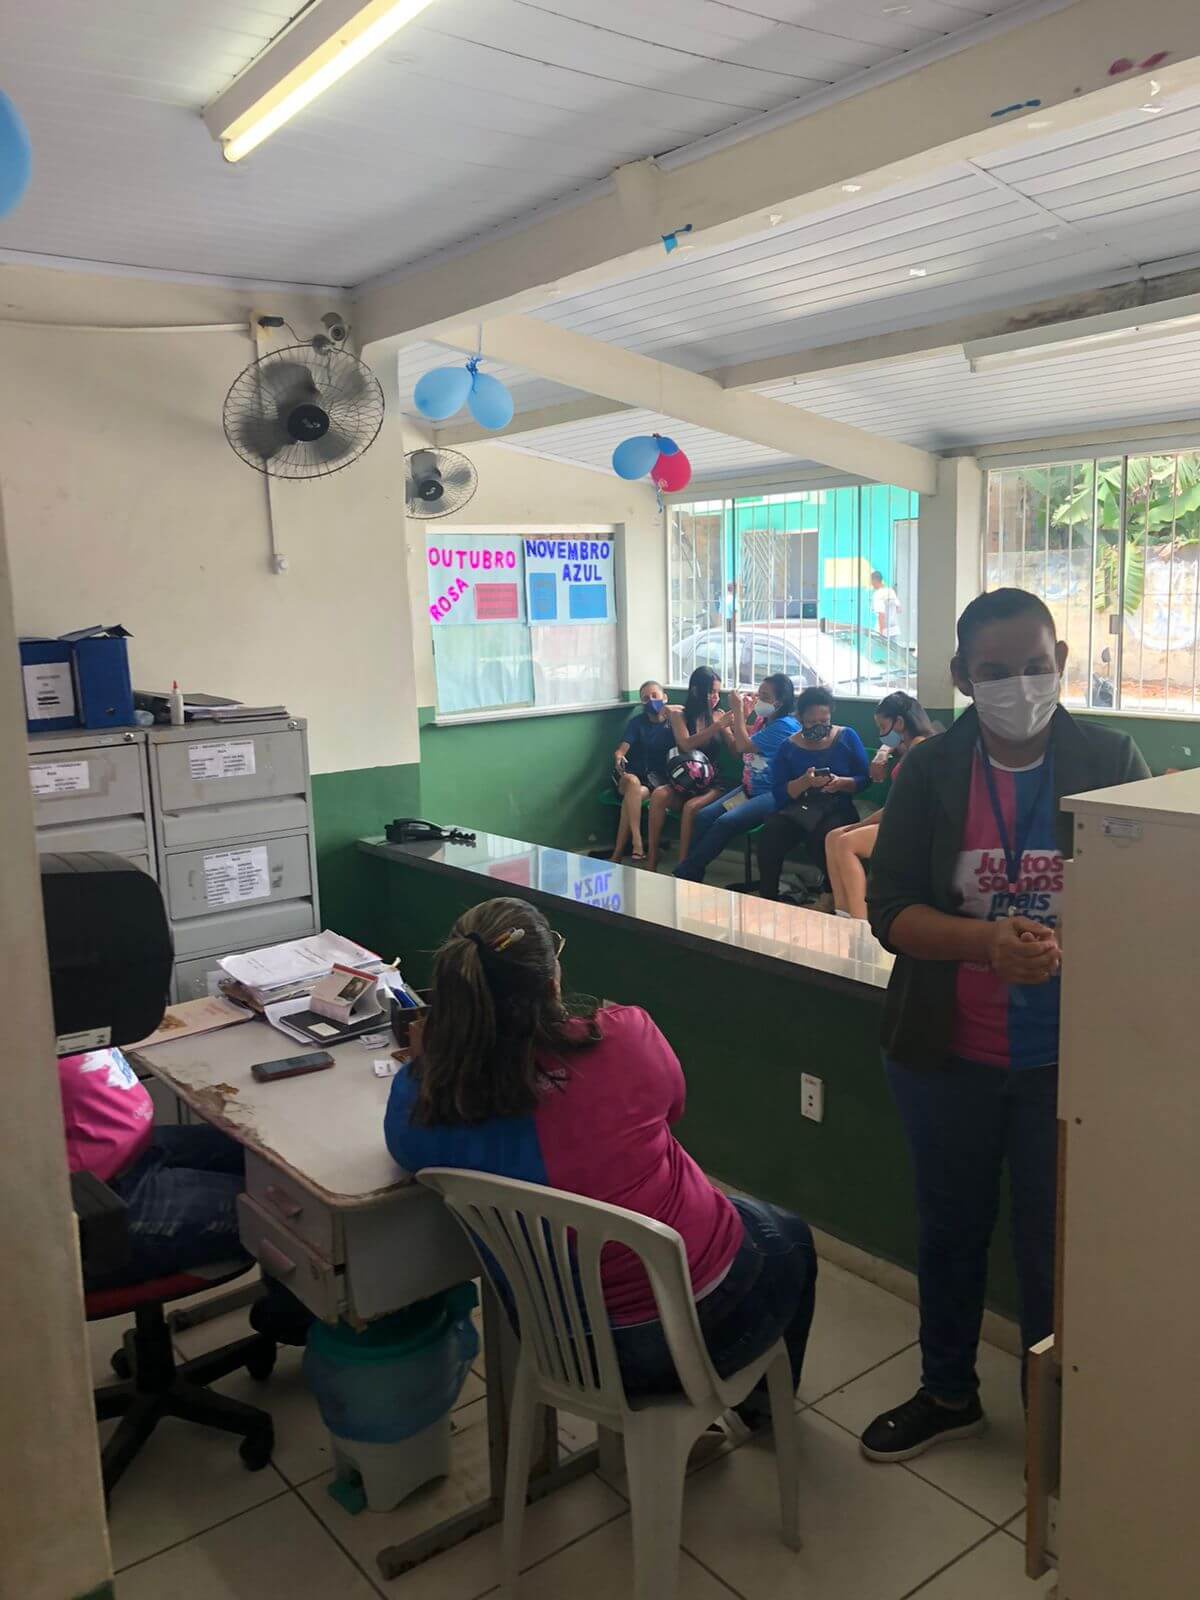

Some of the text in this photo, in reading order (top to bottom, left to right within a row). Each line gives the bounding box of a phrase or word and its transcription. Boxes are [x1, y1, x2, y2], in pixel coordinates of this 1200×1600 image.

[428, 547, 516, 570] OUTUBRO
[526, 540, 610, 560] NOVEMBRO
[562, 564, 602, 582] AZUL
[428, 577, 469, 623] ROSA
[974, 852, 1064, 874] Jutos
